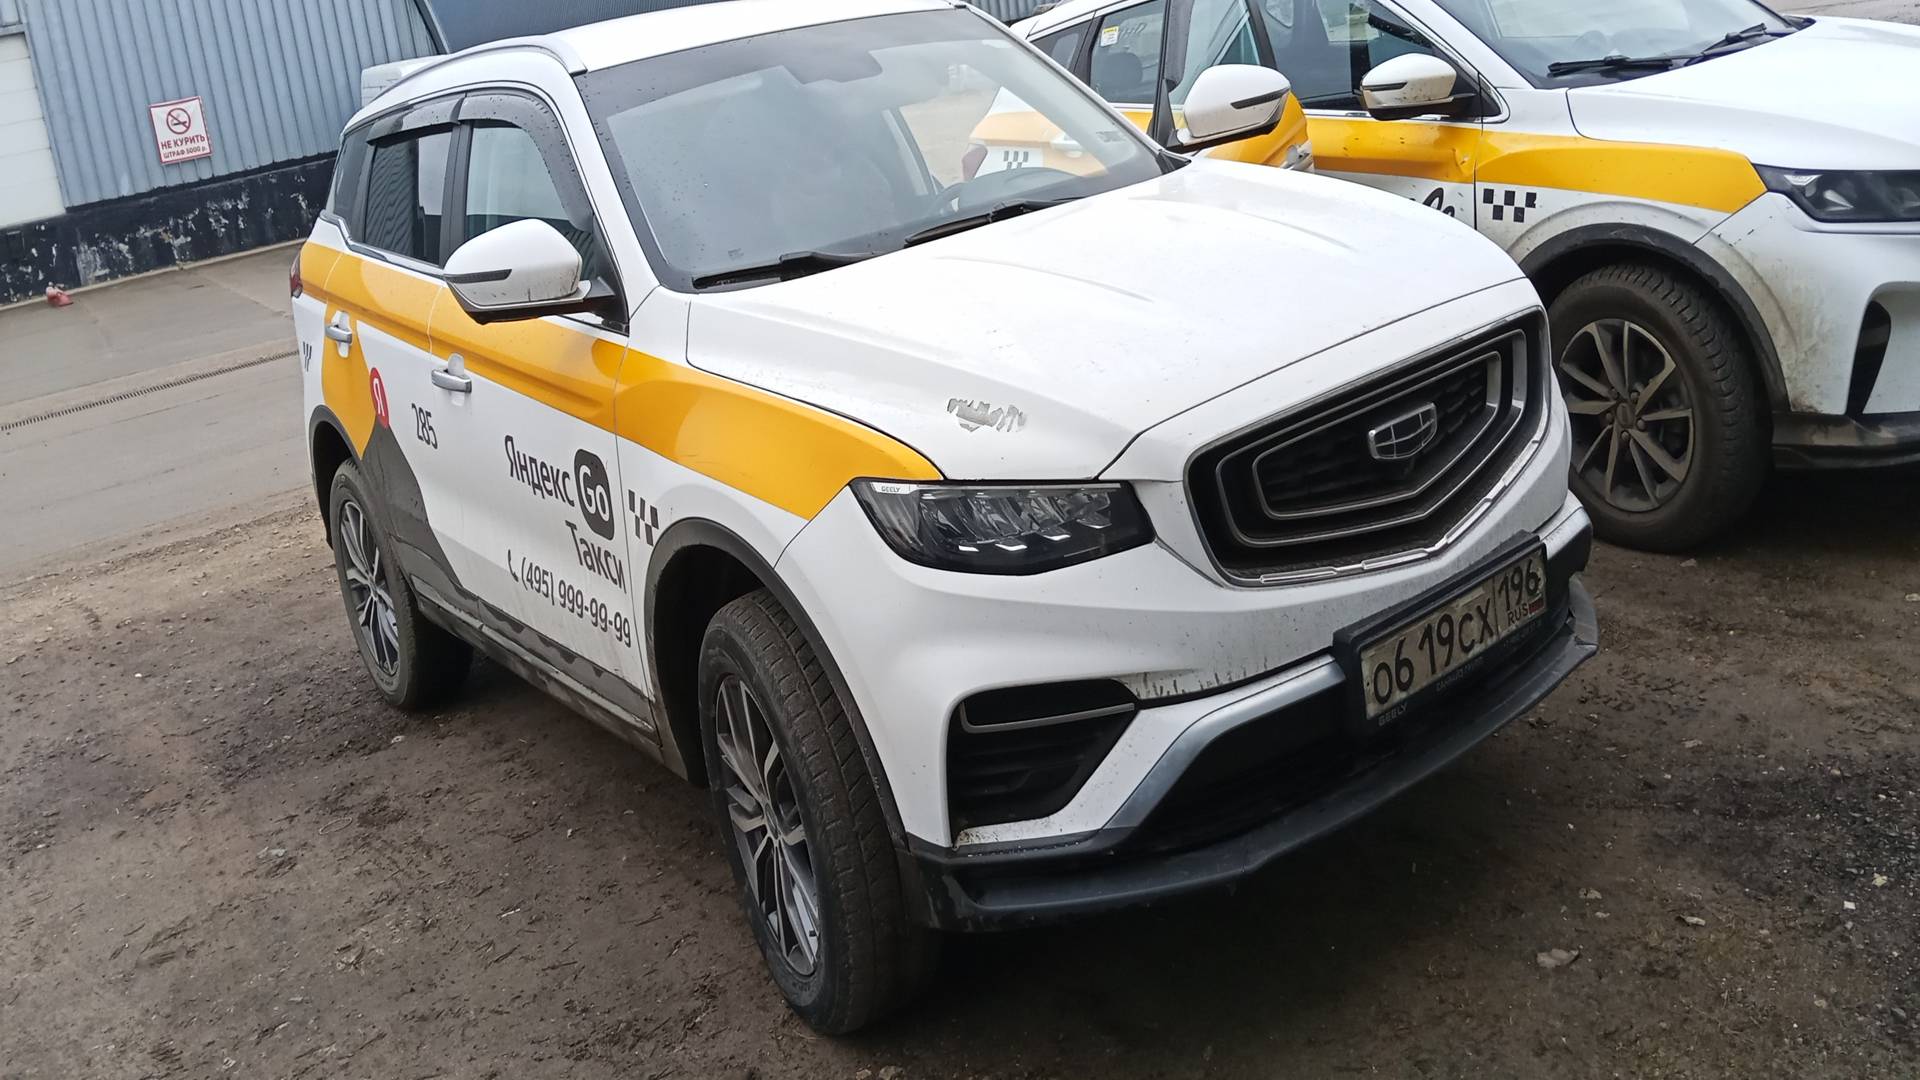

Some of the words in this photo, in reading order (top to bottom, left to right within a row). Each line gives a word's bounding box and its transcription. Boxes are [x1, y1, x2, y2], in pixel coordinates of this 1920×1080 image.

[161, 141, 173, 150] НЕ
[174, 134, 206, 148] КУРИТЬ
[163, 149, 185, 159] ШТРАФ
[186, 146, 201, 155] 5000
[411, 403, 438, 450] 285
[504, 434, 576, 508] Яндекс
[579, 464, 610, 522] Go
[564, 519, 627, 595] Такси
[521, 556, 555, 607] (495)
[558, 579, 632, 649] 999-99-99
[1500, 559, 1542, 611] 196
[1507, 602, 1529, 625] RUS
